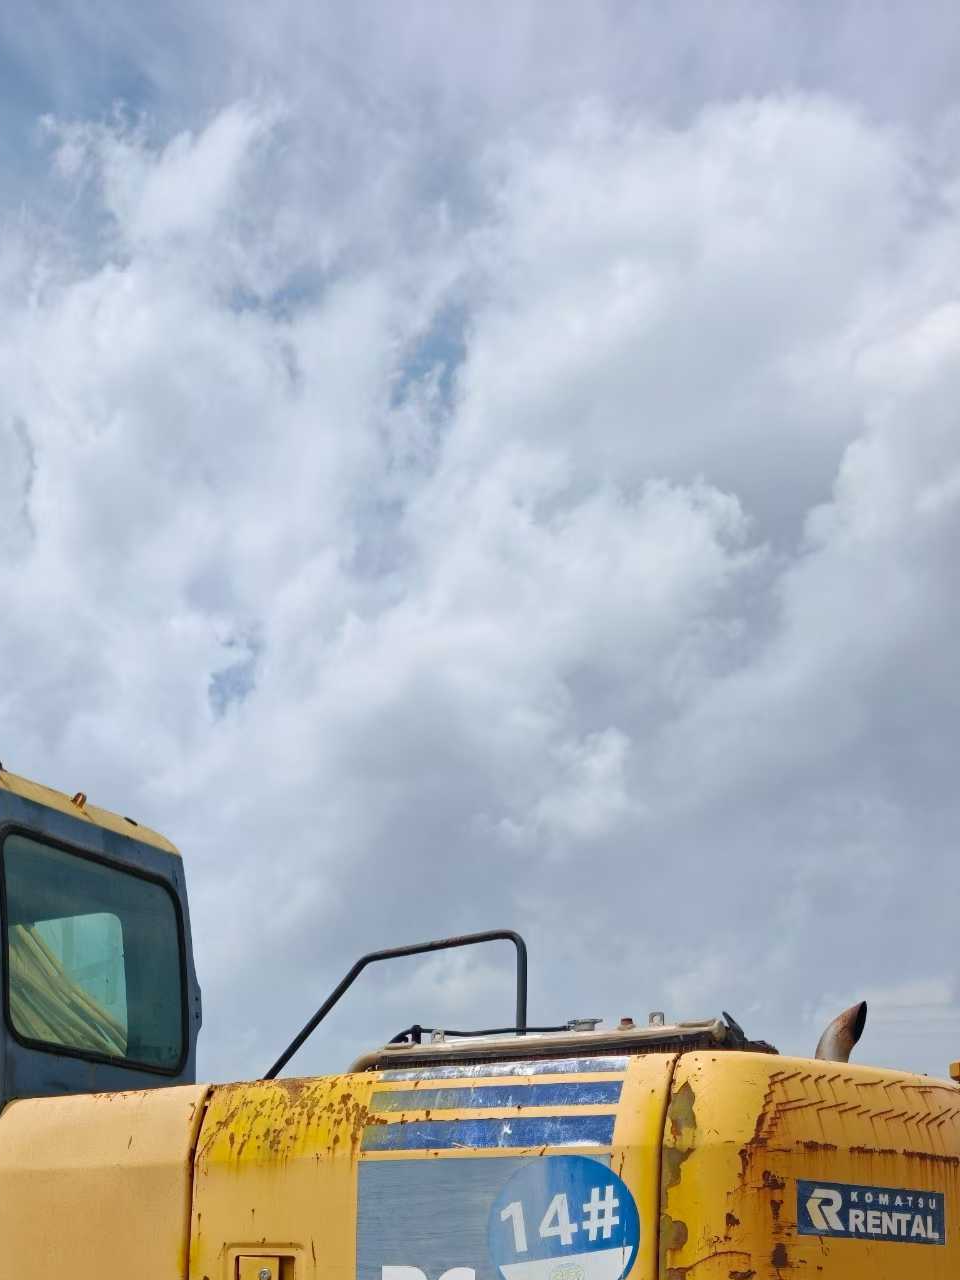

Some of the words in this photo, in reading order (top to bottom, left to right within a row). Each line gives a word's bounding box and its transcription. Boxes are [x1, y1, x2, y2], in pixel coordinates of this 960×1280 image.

[850, 1191, 937, 1210] KOMATSU
[500, 1184, 620, 1253] 14#
[848, 1208, 939, 1239] RENTAL
